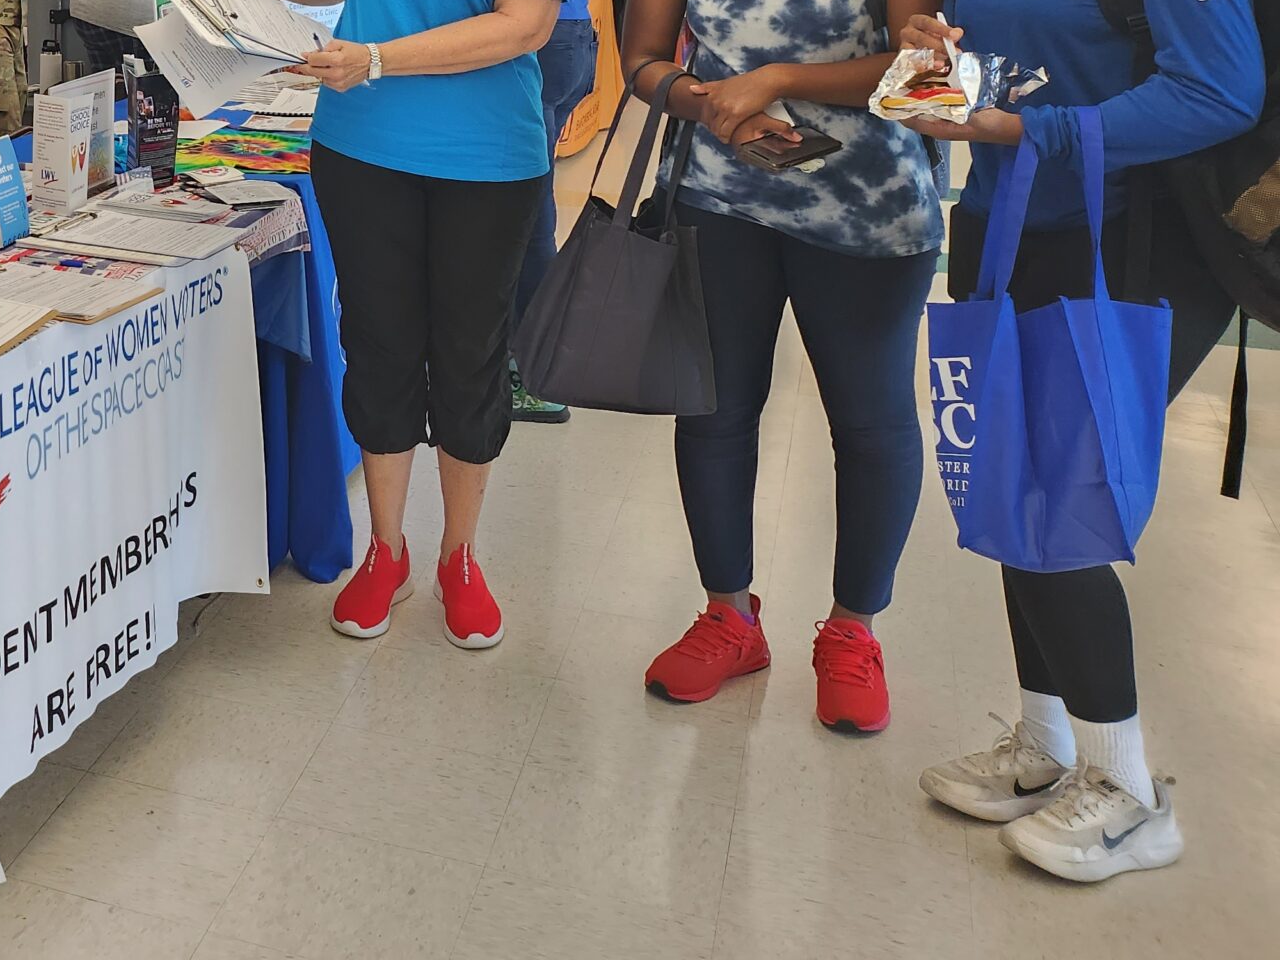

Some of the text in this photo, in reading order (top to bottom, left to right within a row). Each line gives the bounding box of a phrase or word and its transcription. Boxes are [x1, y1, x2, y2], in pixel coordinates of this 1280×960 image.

[70, 109, 91, 123] SCHOOL
[70, 120, 90, 133] CHOICE
[0, 350, 79, 439] LEAGUE
[83, 345, 103, 388] OF
[106, 303, 168, 371] WOMEN
[931, 357, 972, 401] F
[25, 339, 184, 480] OF THE SPACE COAS
[932, 403, 976, 449] C
[30, 603, 156, 754] ARE FREE!
